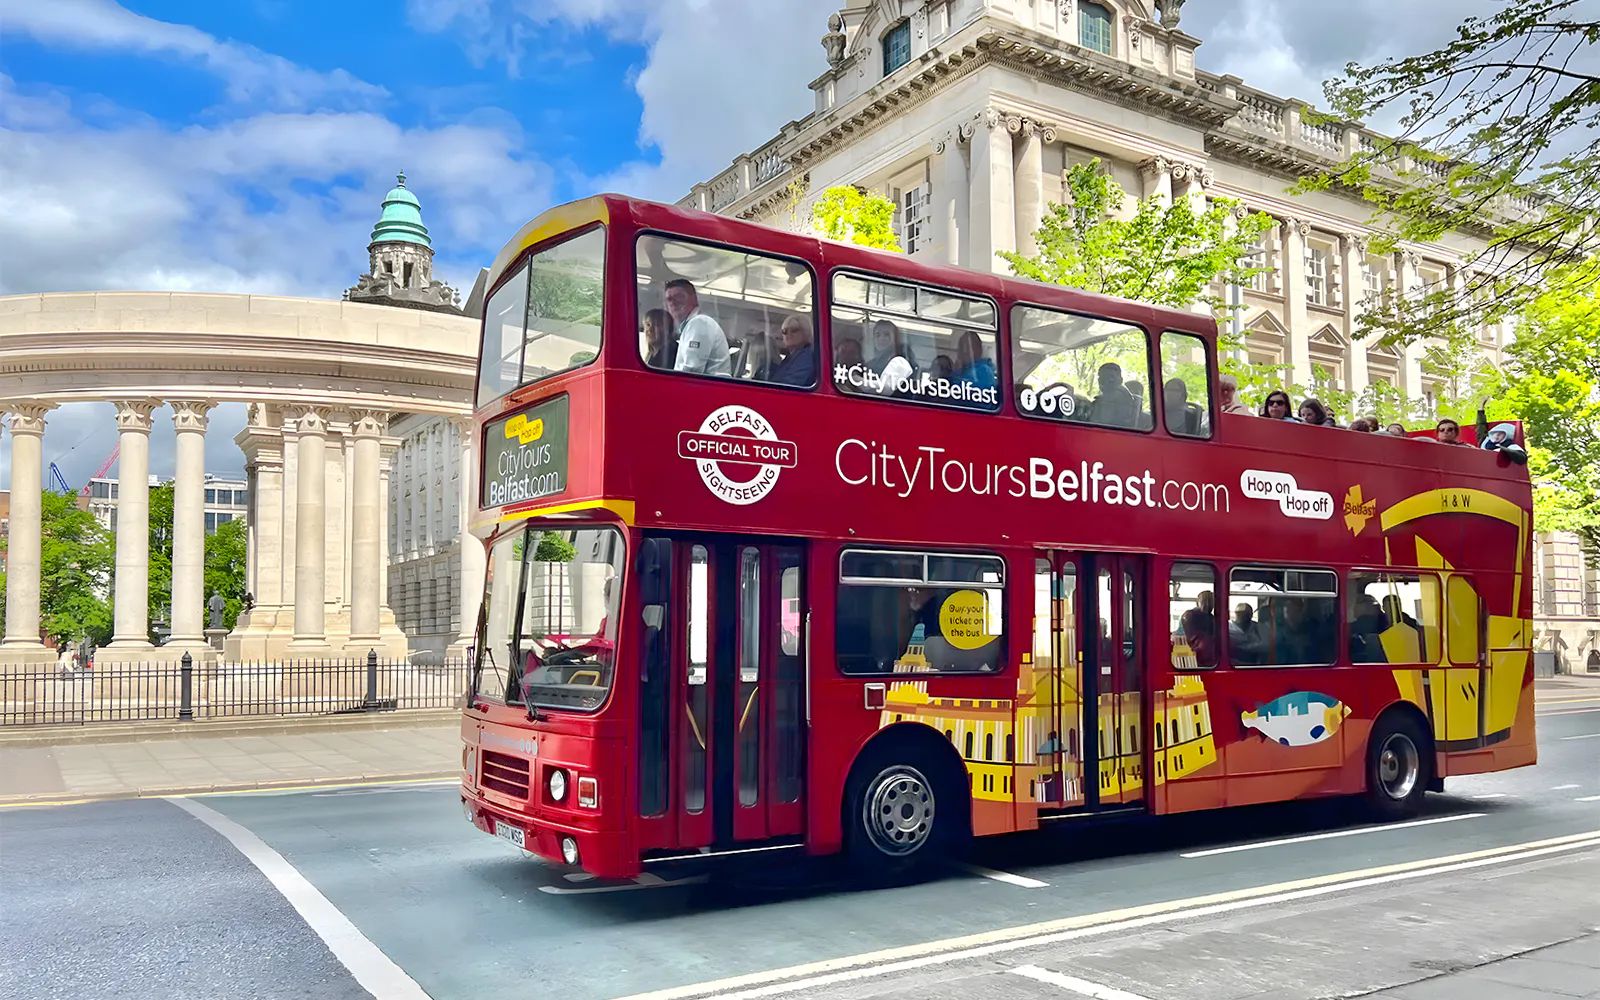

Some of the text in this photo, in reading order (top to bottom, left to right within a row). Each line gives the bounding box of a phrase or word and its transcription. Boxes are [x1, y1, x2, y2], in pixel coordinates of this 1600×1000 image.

[834, 362, 998, 405] #CityToursBelfast
[709, 411, 769, 436] BELFAST
[498, 443, 550, 478] CityTours
[687, 438, 790, 461] OFFICIAL TOUR
[702, 462, 775, 500] SIGHTSEEING
[835, 438, 1230, 512] CityToursBelfast.com
[1247, 476, 1290, 495] Hop on
[490, 472, 558, 505] Belfast.com
[1286, 496, 1329, 514] Hop off
[1451, 495, 1458, 507] &
[1461, 494, 1470, 508] W
[948, 604, 964, 614] Buy
[949, 616, 972, 625] ticket
[950, 628, 980, 637] the bus
